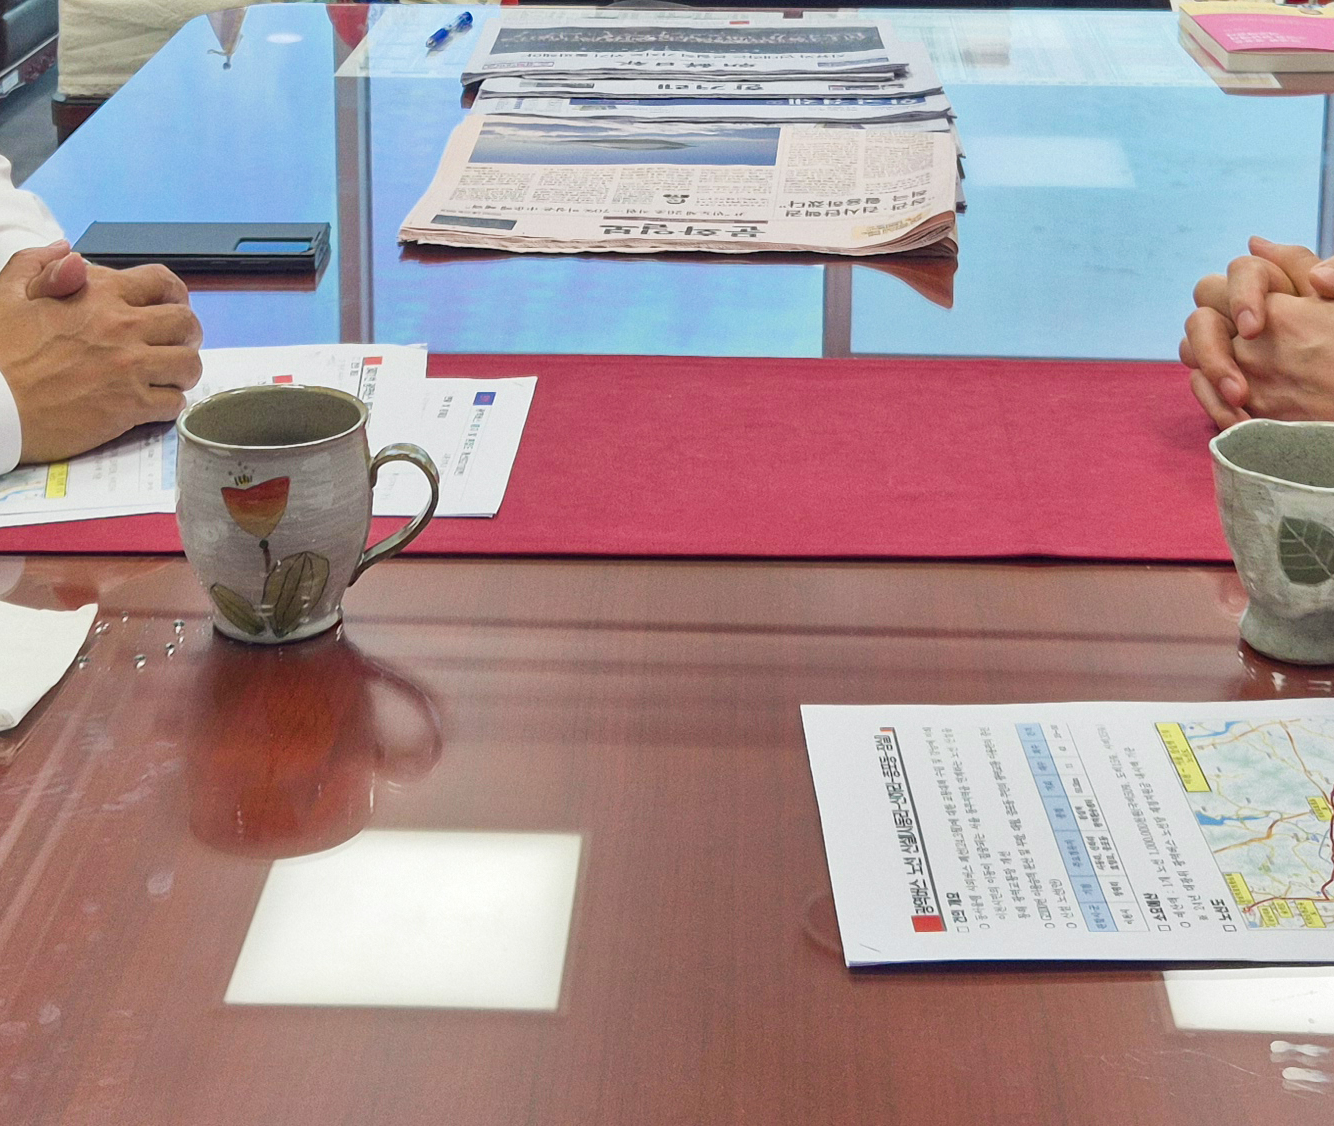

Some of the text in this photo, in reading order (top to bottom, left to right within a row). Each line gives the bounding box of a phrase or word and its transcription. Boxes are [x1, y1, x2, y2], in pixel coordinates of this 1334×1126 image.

[598, 223, 767, 239] 문화일보
[903, 856, 923, 875] 노선
[907, 878, 934, 914] 광역버스
[1143, 892, 1167, 921] 소요예산
[950, 909, 967, 923] 건의
[1210, 898, 1232, 921] 노선도
